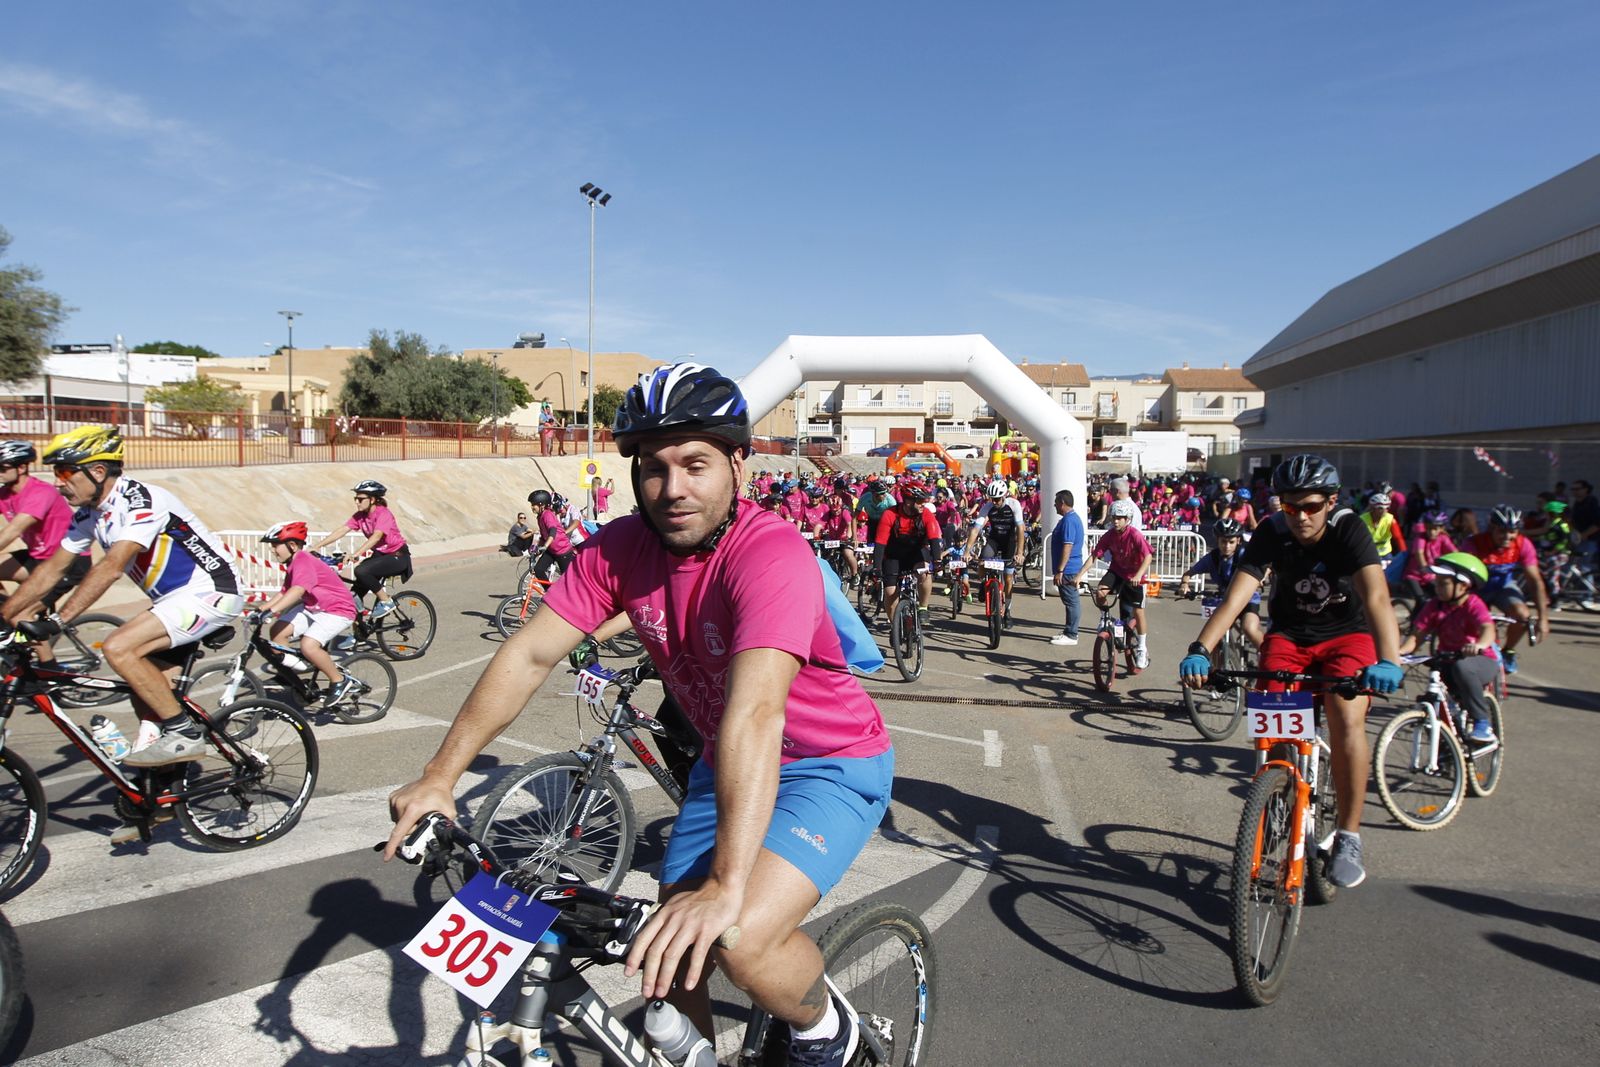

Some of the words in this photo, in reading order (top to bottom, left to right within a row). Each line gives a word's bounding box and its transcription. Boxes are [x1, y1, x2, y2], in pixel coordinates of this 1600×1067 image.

[182, 534, 221, 572] Banesto
[578, 673, 601, 699] 155
[1254, 712, 1304, 735] 313
[790, 827, 828, 856] ellesse
[420, 914, 513, 987] 305
